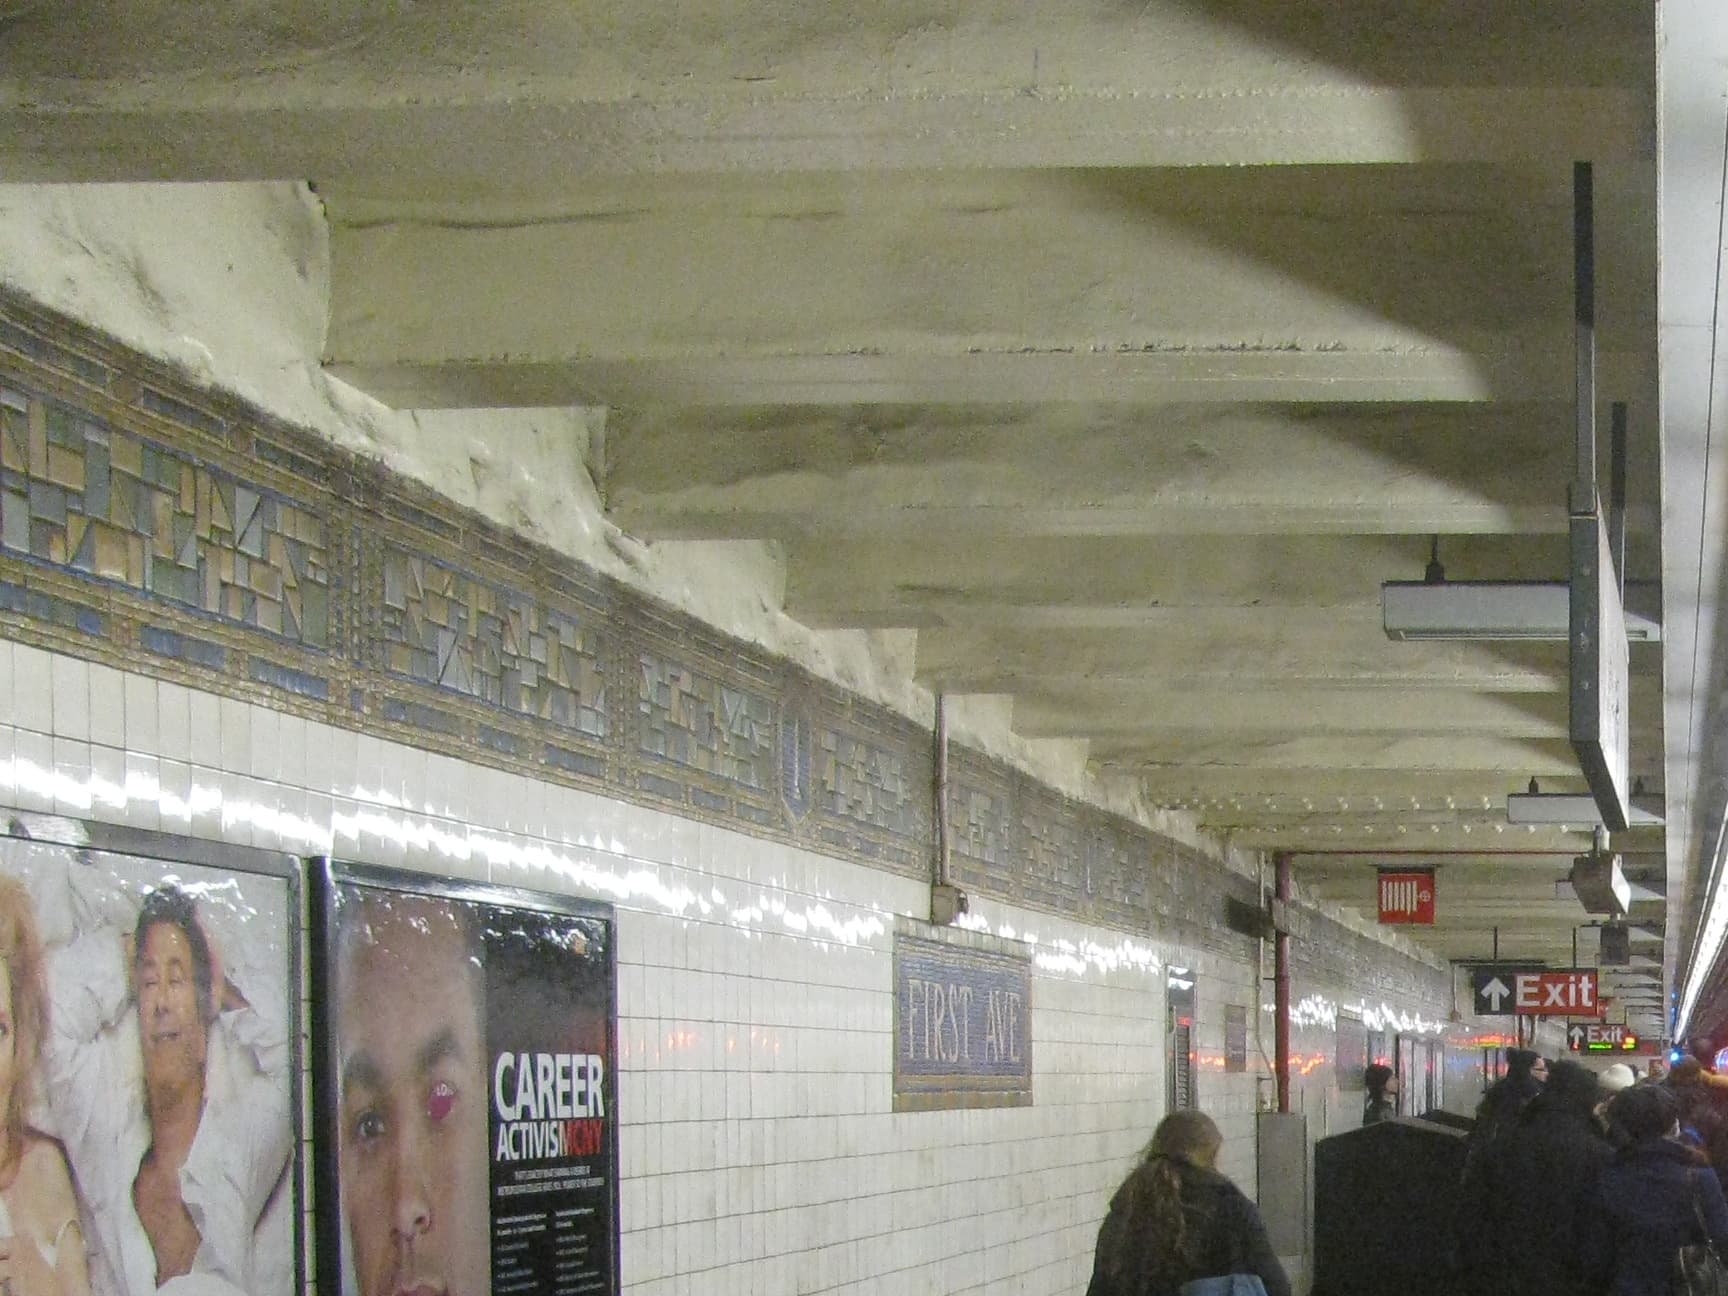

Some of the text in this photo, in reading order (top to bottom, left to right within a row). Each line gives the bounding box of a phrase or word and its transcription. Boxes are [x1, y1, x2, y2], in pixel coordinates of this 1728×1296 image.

[1515, 974, 1593, 1008] Exit
[907, 978, 1023, 1063] FIRST AVE
[1586, 1025, 1623, 1043] Exit
[494, 1051, 605, 1121] CAREER
